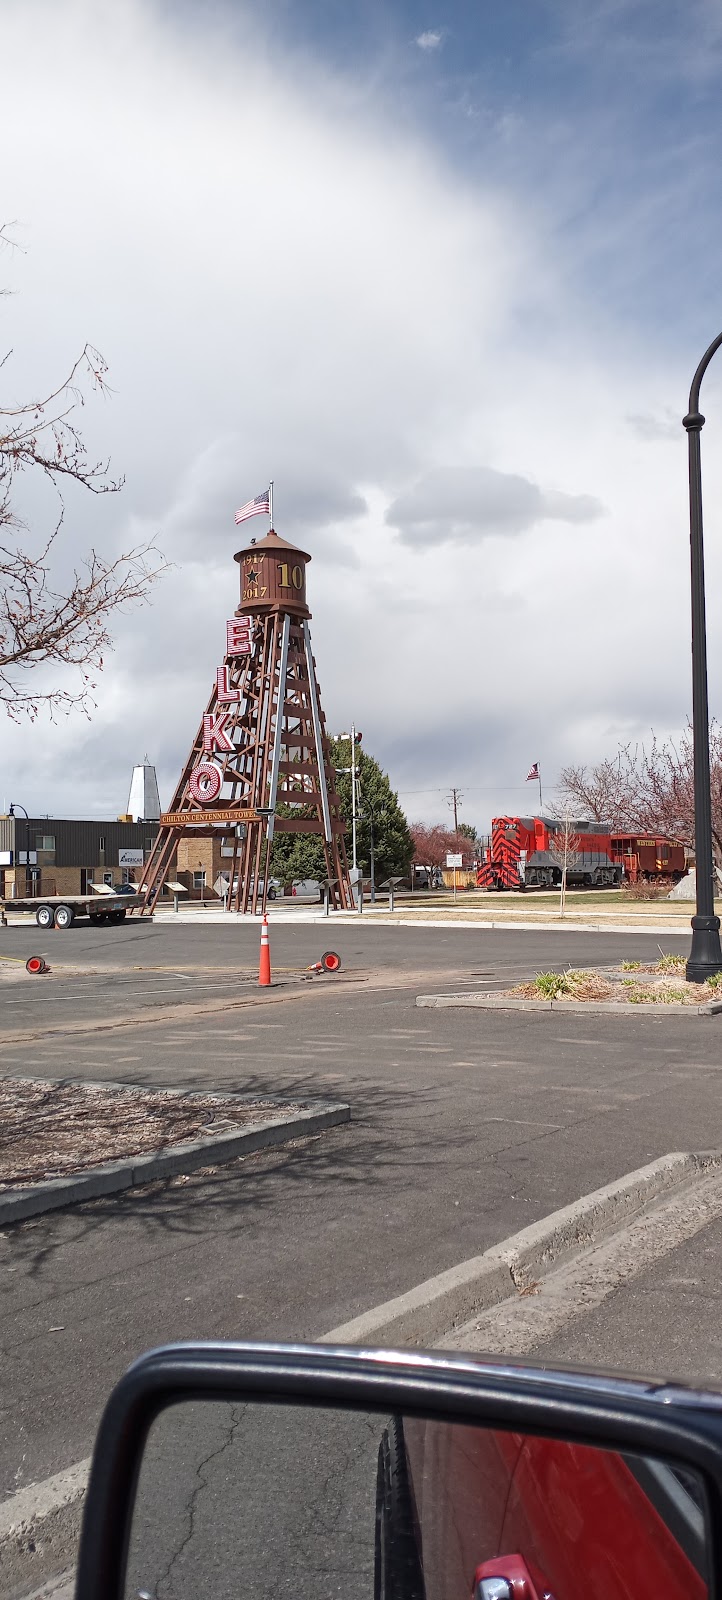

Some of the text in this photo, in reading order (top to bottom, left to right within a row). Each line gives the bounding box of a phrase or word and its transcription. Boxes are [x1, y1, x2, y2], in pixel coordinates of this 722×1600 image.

[242, 552, 266, 567] 1917
[242, 586, 268, 601] 2017
[189, 615, 253, 802] ELKO
[162, 813, 190, 823] CHILTON
[191, 811, 233, 821] CENTENNIAL
